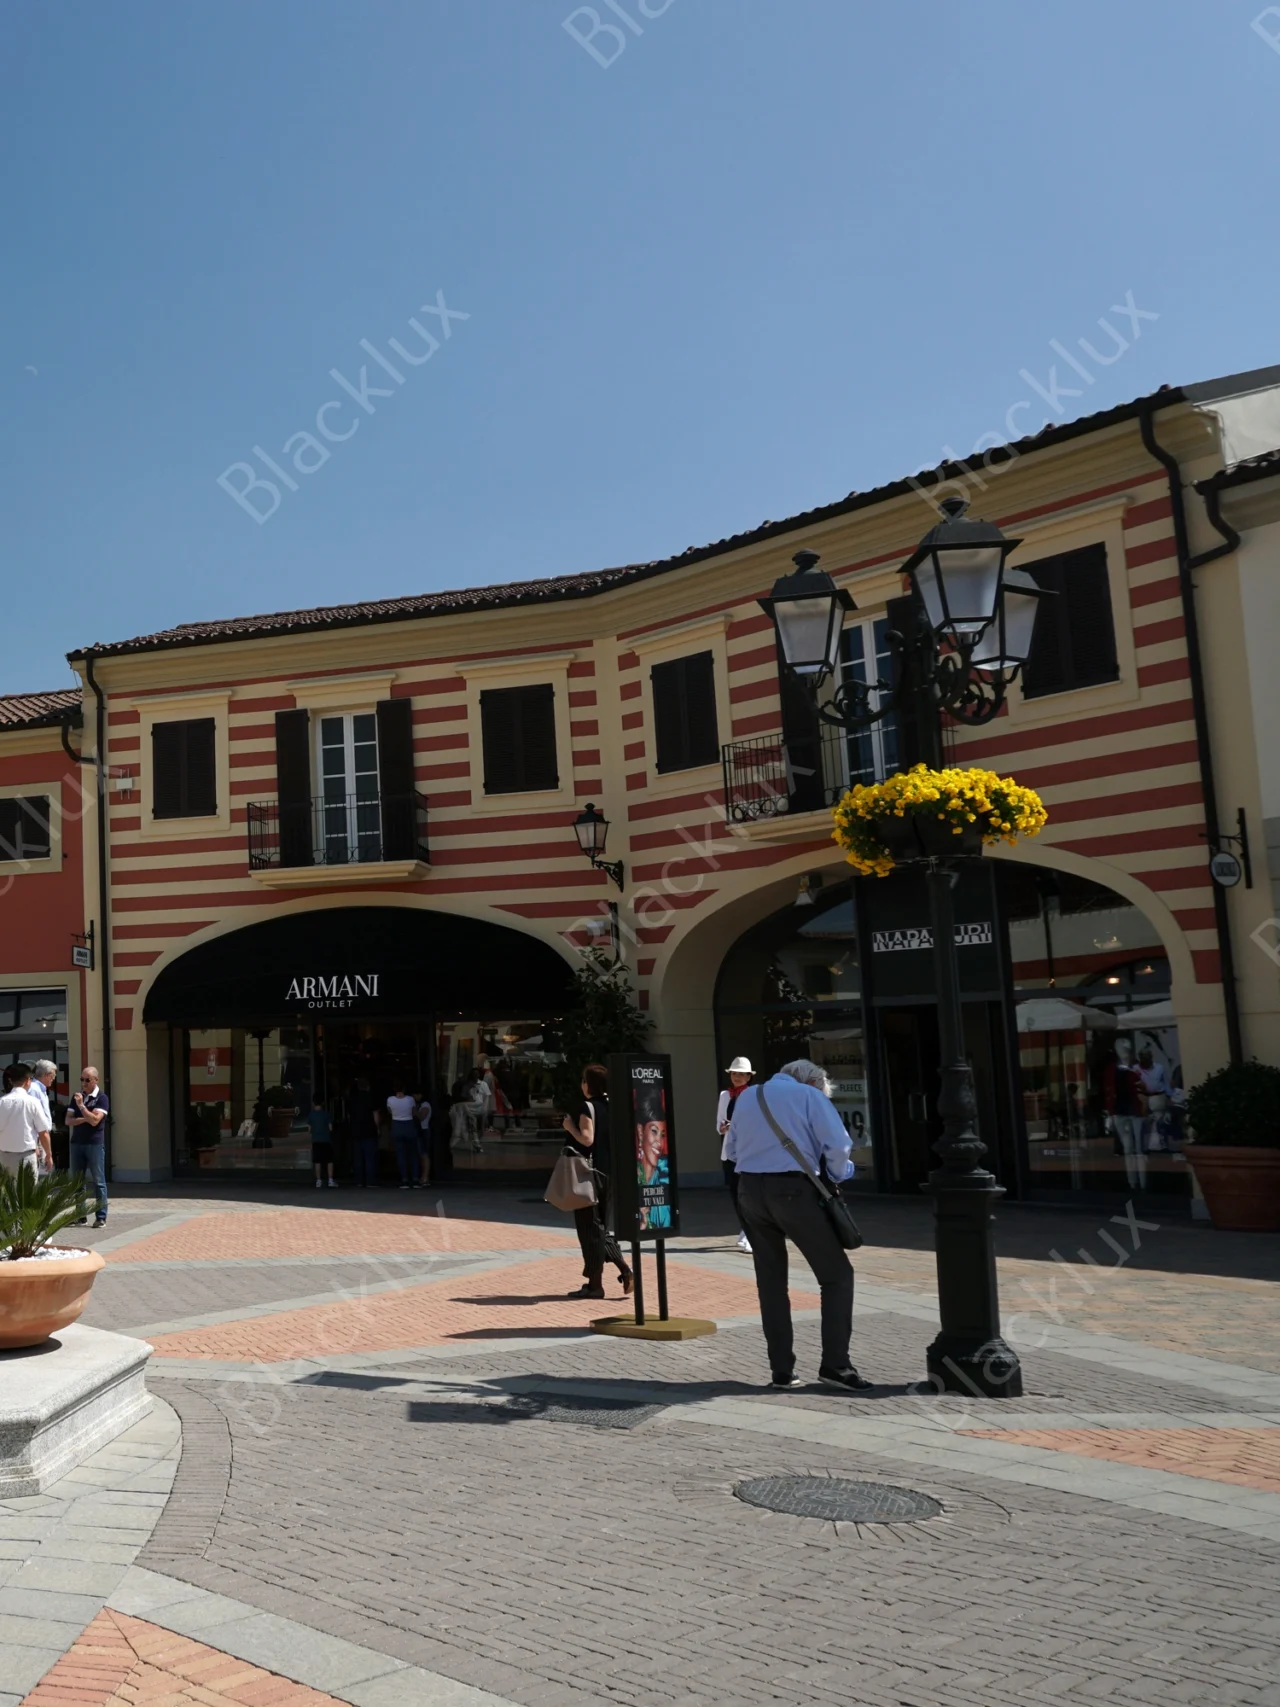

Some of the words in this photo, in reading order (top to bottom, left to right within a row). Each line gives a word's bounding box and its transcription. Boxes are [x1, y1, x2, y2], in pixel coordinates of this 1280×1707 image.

[873, 922, 991, 951] NAPAJRI
[284, 974, 379, 1000] ARMANI
[308, 1000, 353, 1009] OUTLET
[839, 1083, 863, 1093] FLEECE
[644, 1197, 652, 1206] TU
[652, 1196, 665, 1205] VALI
